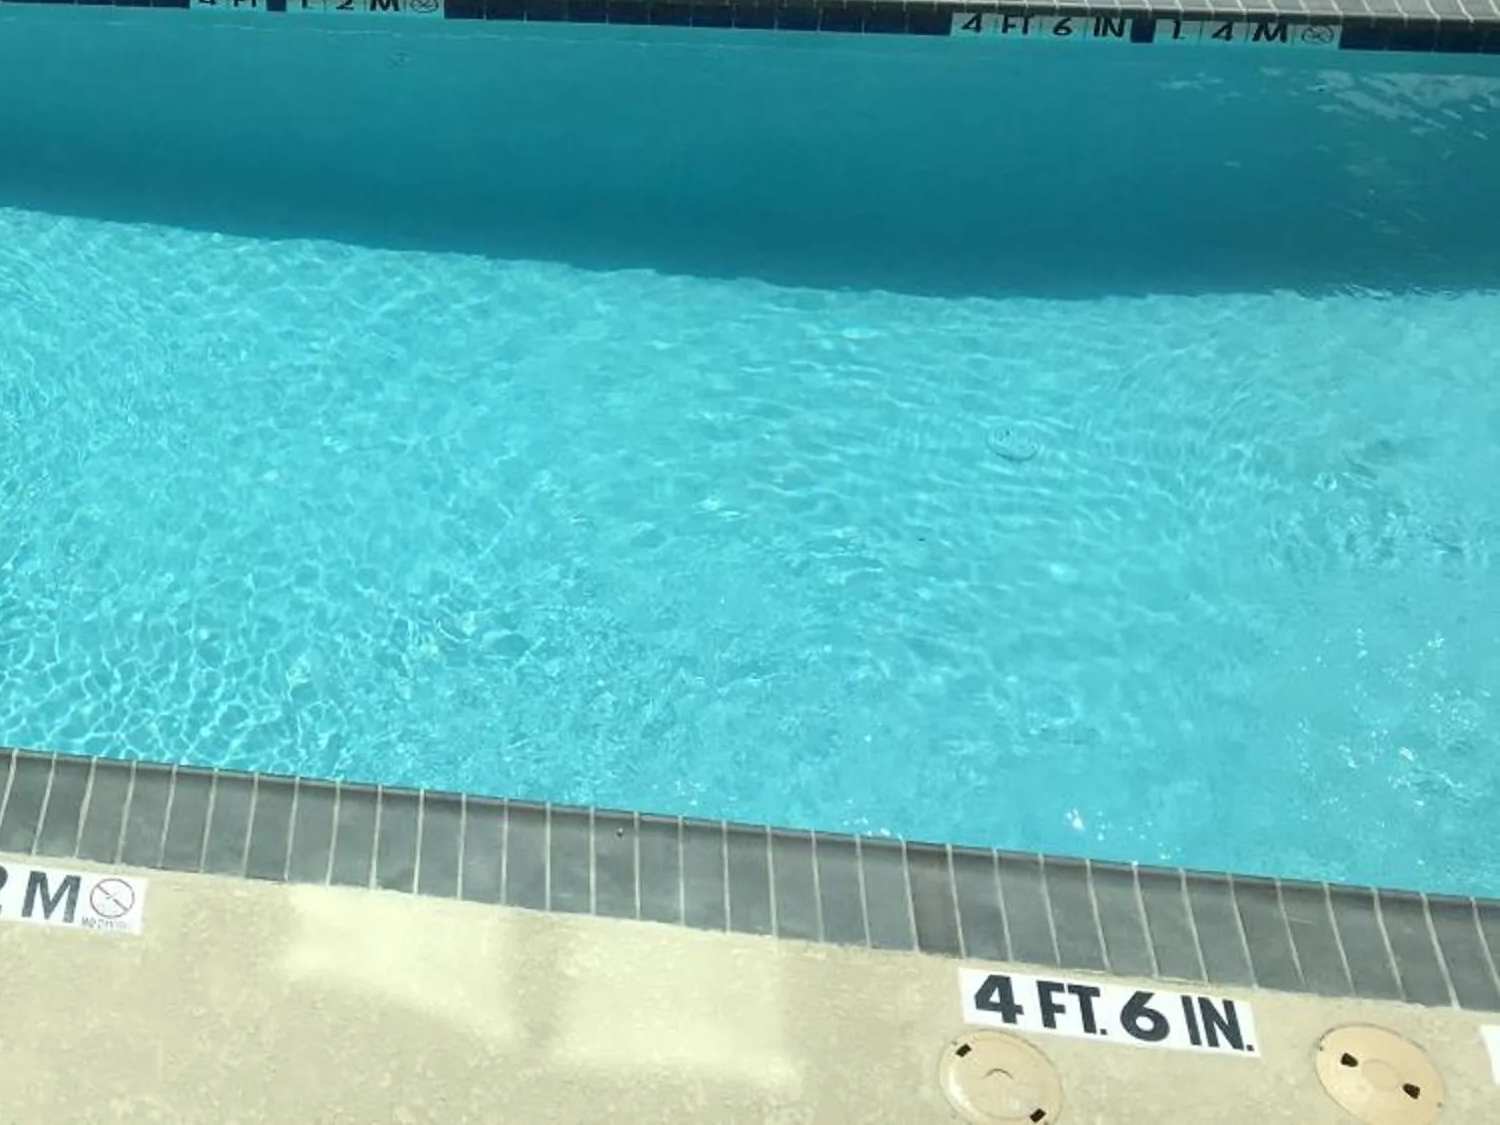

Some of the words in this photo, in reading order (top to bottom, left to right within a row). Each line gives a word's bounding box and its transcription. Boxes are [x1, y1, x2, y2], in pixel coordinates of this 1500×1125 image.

[961, 12, 983, 33] 4
[1002, 14, 1035, 35] FT
[1052, 17, 1073, 36] 6
[1093, 16, 1128, 38] IN
[1252, 21, 1288, 44] M
[21, 870, 82, 924] M
[974, 973, 1024, 1024] 4
[1036, 980, 1108, 1036] FT.
[1120, 991, 1171, 1043] 6
[1181, 994, 1255, 1052] IN.
